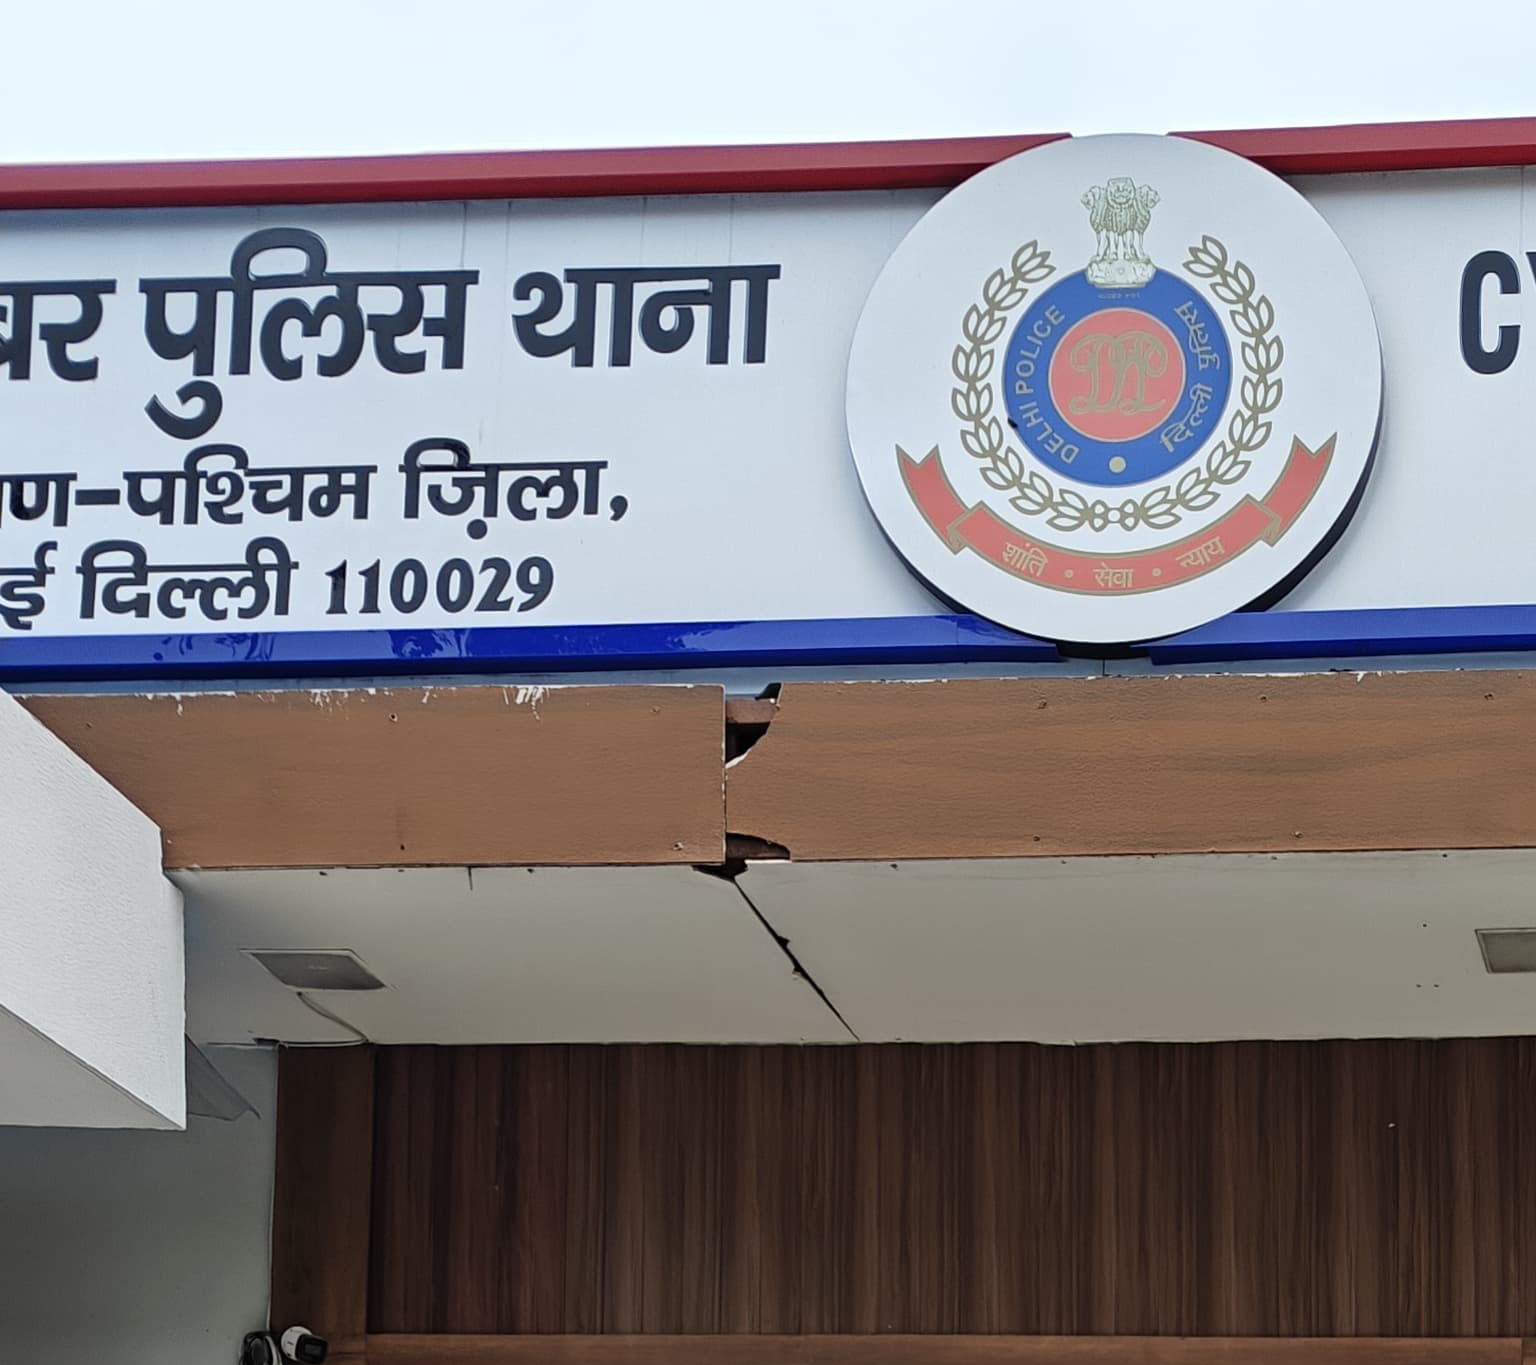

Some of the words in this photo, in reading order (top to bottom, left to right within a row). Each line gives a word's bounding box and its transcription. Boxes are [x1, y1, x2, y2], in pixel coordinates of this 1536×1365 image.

[138, 227, 480, 439] पुलिस
[511, 264, 782, 368] थाना
[1016, 304, 1065, 394] POLICE
[1019, 401, 1079, 464] DELHI
[0, 444, 378, 529] ण-पश्चिम
[76, 536, 299, 621] दिल्ली
[325, 556, 554, 615] 110029
[1093, 563, 1133, 588] सेवा
[1176, 536, 1225, 569] न्याय
